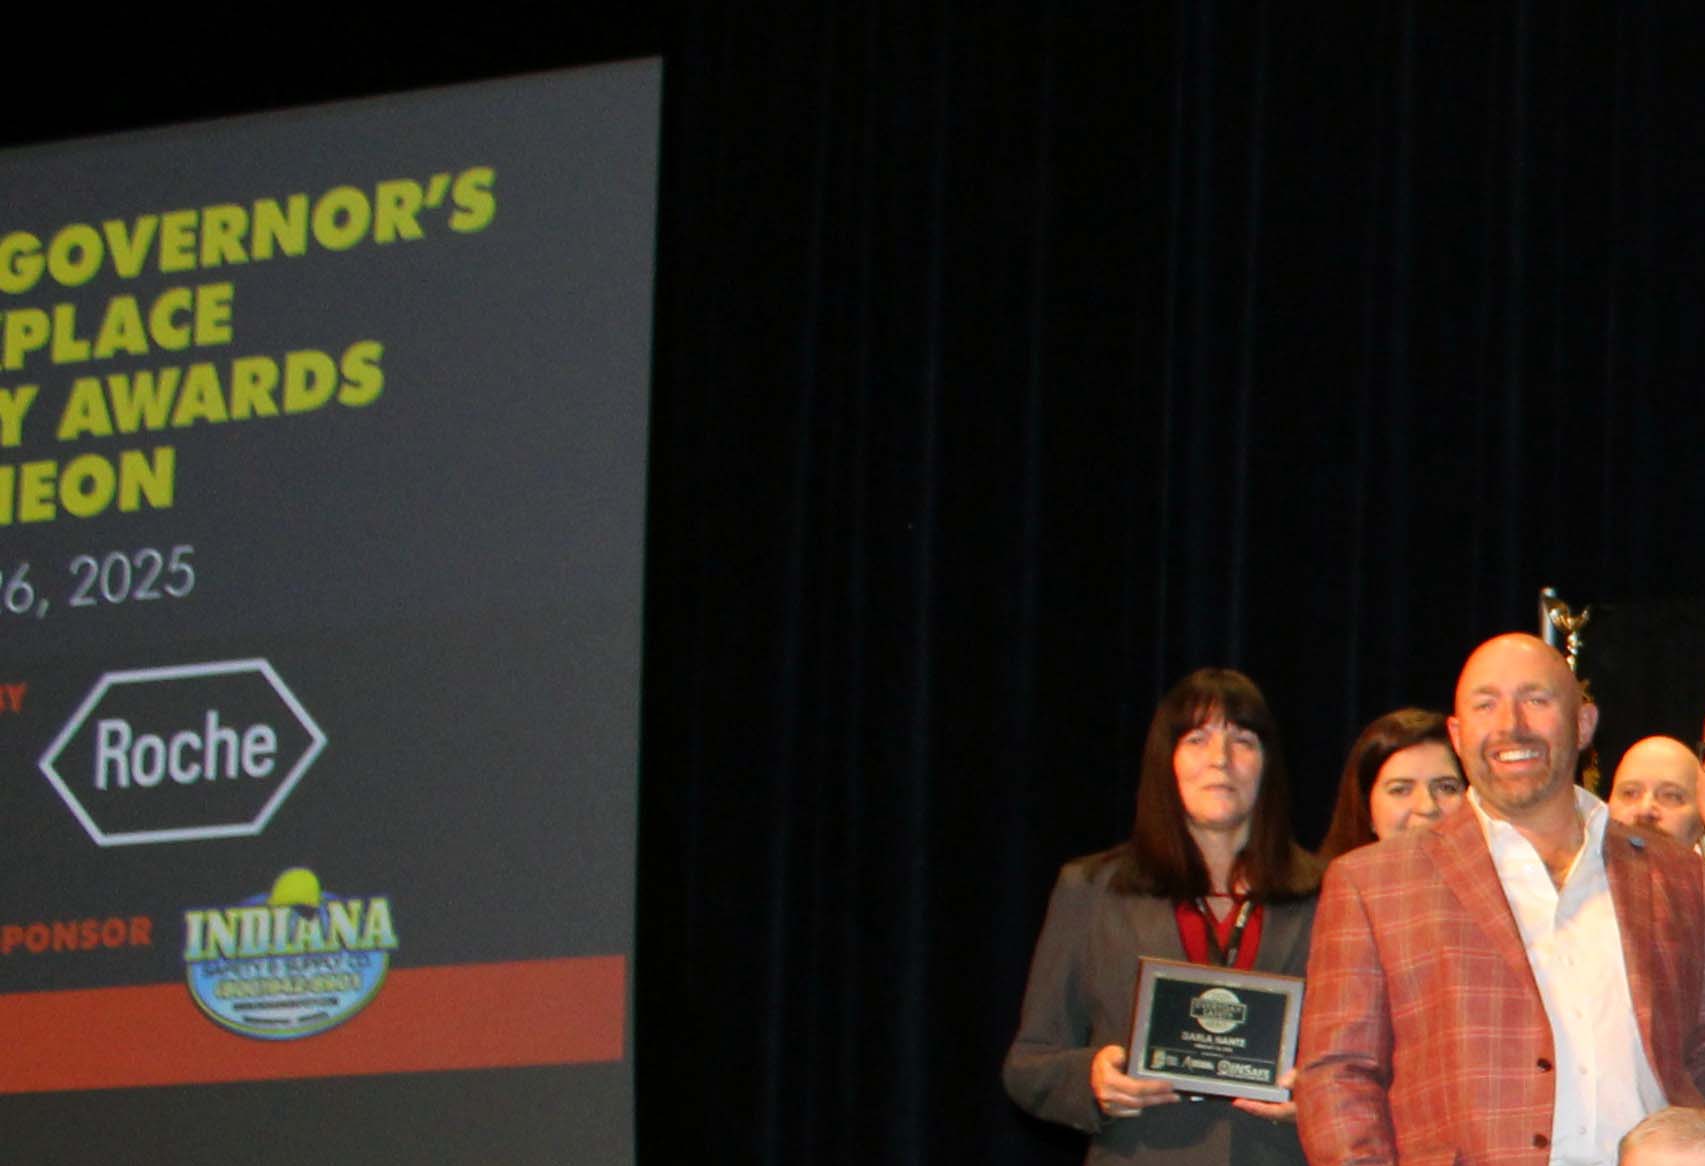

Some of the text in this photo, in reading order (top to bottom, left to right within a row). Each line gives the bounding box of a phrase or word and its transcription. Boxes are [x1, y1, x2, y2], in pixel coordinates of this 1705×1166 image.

[0, 168, 496, 294] GOVERNOR'S
[0, 283, 233, 371] PLACE
[56, 340, 385, 440] AWARDS
[0, 545, 195, 620] 6, 2025
[95, 711, 277, 790] Roche
[0, 915, 153, 956] PONSOR
[183, 897, 399, 962] INDIANA
